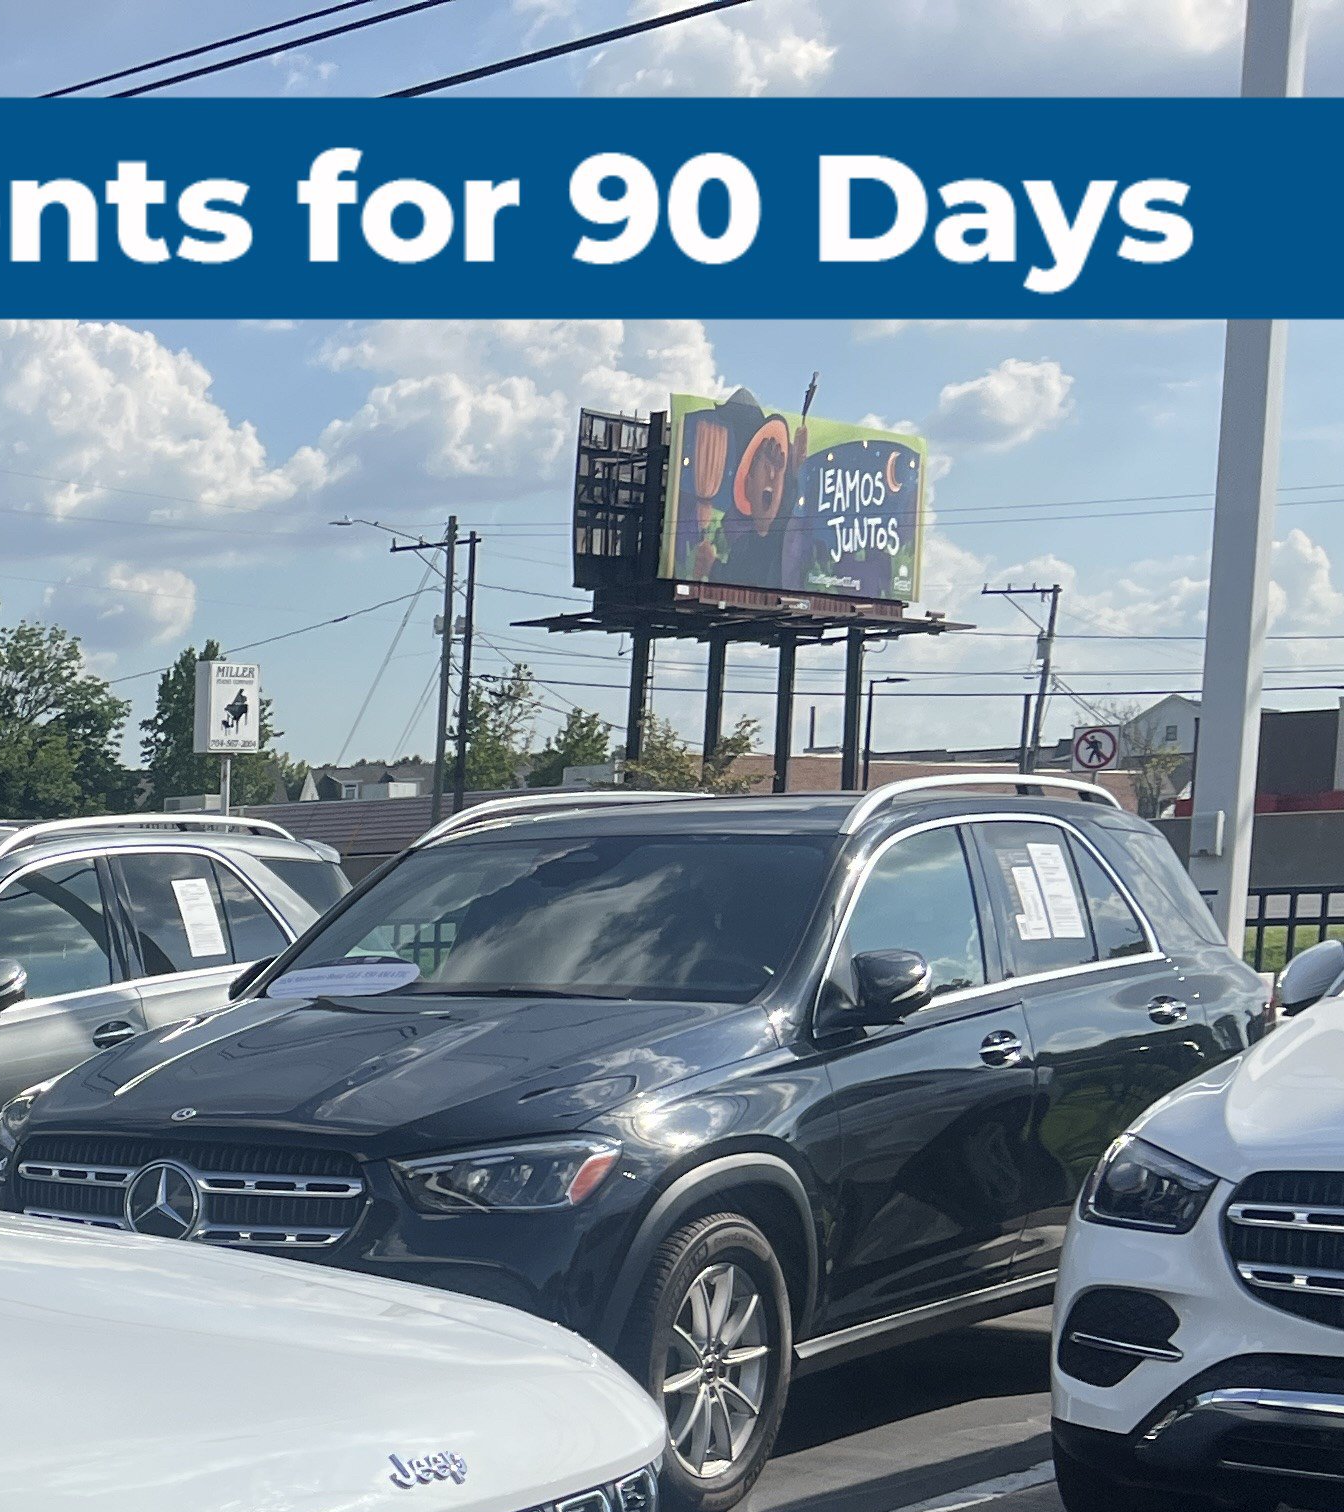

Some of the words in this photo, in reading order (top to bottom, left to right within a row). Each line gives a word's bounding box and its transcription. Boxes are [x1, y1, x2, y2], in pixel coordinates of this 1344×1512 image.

[817, 467, 886, 513] LEAMOS
[215, 666, 255, 678] MILLER
[389, 1451, 468, 1489] Jeep
